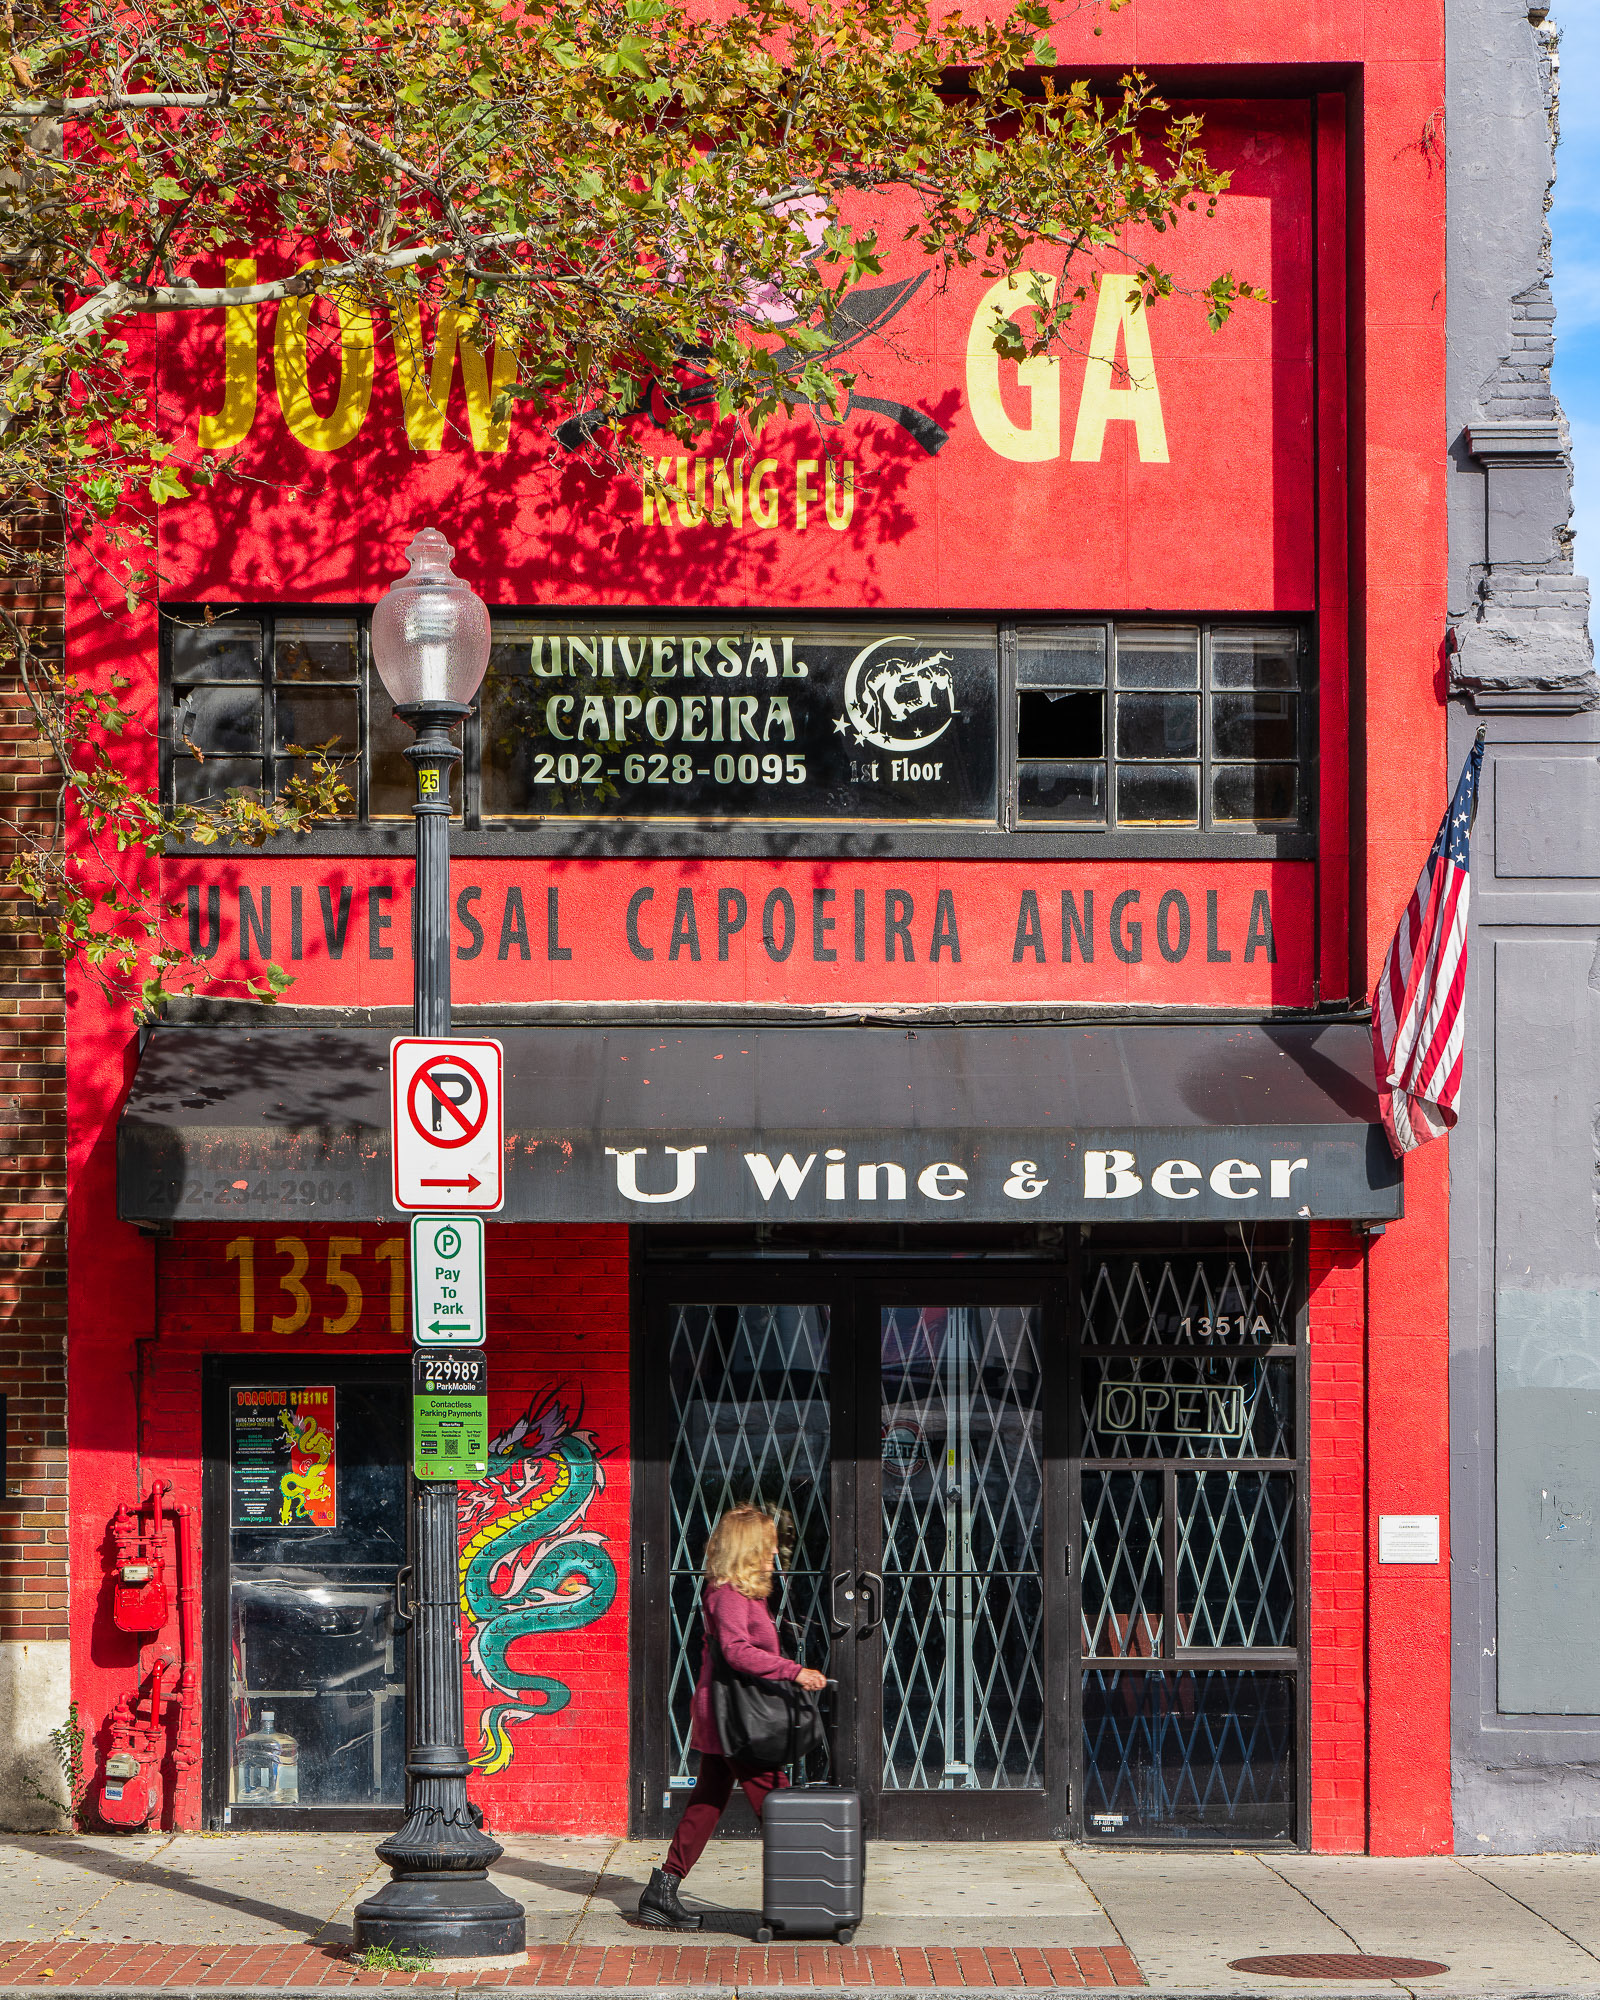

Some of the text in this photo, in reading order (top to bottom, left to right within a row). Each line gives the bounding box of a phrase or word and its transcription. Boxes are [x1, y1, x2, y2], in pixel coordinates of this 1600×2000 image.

[197, 258, 1171, 464] JOW GA
[641, 456, 855, 531] KUNG FU
[530, 635, 809, 678] UNIVERSAL
[545, 695, 796, 742] CAPOEIRA
[421, 773, 438, 790] 25
[533, 753, 808, 785] 202-628-0095
[849, 758, 943, 783] 1st Floor
[186, 884, 1279, 964] UNIVESAL CAPOEIRA ANGOLA
[604, 1145, 1309, 1204] U Wine & Beer
[225, 1236, 405, 1334] 1351
[435, 1267, 461, 1282] Pay
[440, 1286, 457, 1299] To
[433, 1302, 464, 1315] Park
[1180, 1315, 1271, 1337] 1351A
[425, 1362, 479, 1381] 229989
[436, 1382, 476, 1392] ParkMobile
[420, 1409, 482, 1419] Parking Payments
[430, 1400, 472, 1409] Contactless
[1105, 1387, 1237, 1434] OPEN
